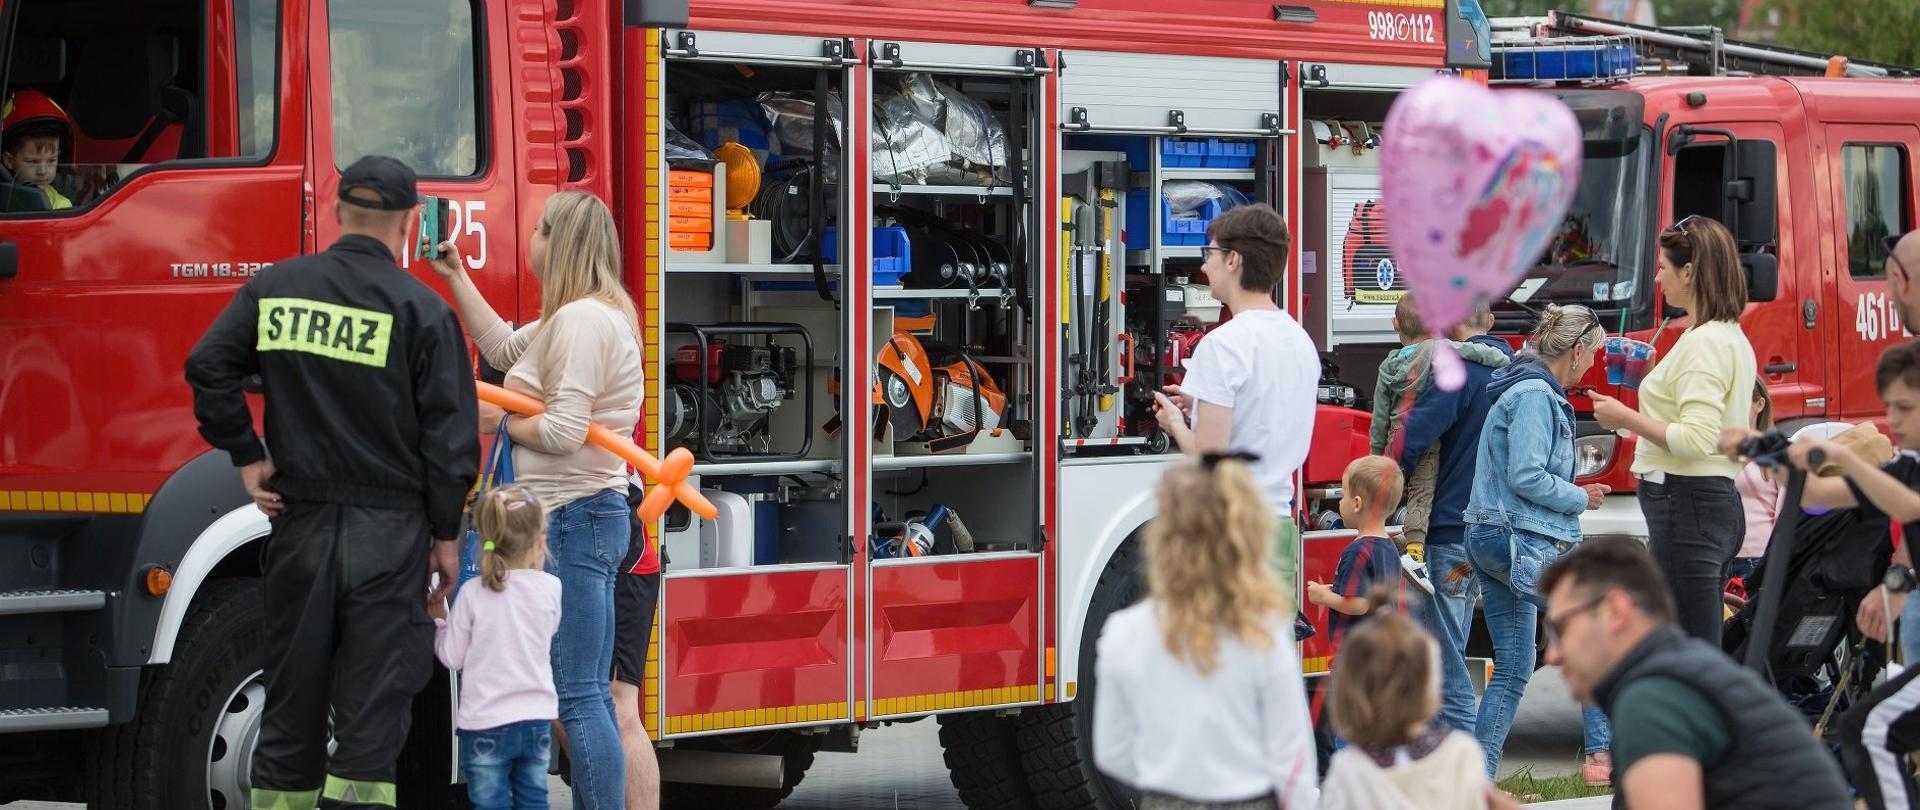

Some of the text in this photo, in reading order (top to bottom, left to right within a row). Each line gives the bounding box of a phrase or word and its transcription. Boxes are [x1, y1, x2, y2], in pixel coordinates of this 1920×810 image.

[1368, 10, 1434, 43] 998 112
[170, 262, 274, 278] TGM 18.32
